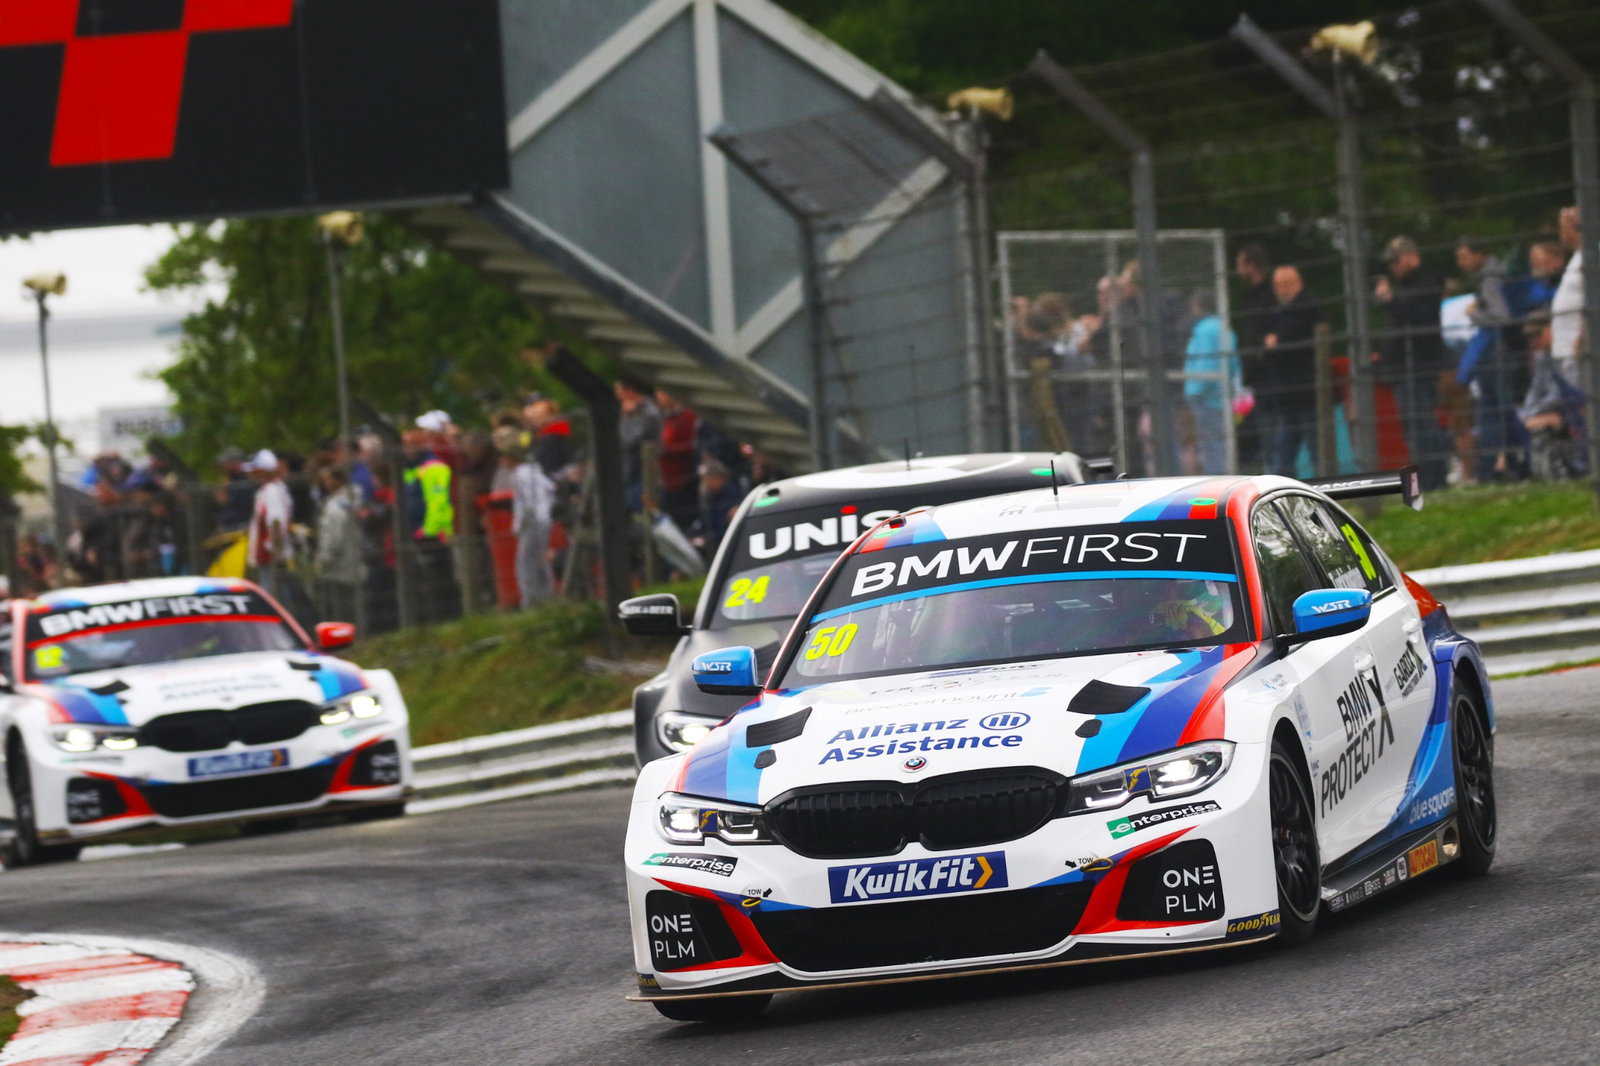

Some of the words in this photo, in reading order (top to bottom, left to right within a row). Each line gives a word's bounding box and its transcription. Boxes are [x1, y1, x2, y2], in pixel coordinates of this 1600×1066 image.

[851, 532, 1207, 597] BMWFIRST
[724, 575, 771, 608] 24
[1311, 599, 1352, 614] WSR
[39, 594, 250, 637] BMWFIRST
[805, 623, 859, 660] 50
[1337, 672, 1373, 742] BMW
[826, 714, 971, 745] Allianz
[818, 733, 1024, 765] Assistance
[1321, 718, 1376, 819] PROTECT
[1110, 803, 1218, 833] enterprise
[649, 855, 734, 873] enterprise
[1078, 857, 1094, 865] TOW
[1163, 865, 1215, 888] ONE
[747, 888, 762, 896] TOW
[1166, 891, 1216, 914] PLM
[651, 913, 693, 934] ONE
[655, 940, 695, 959] PLM
